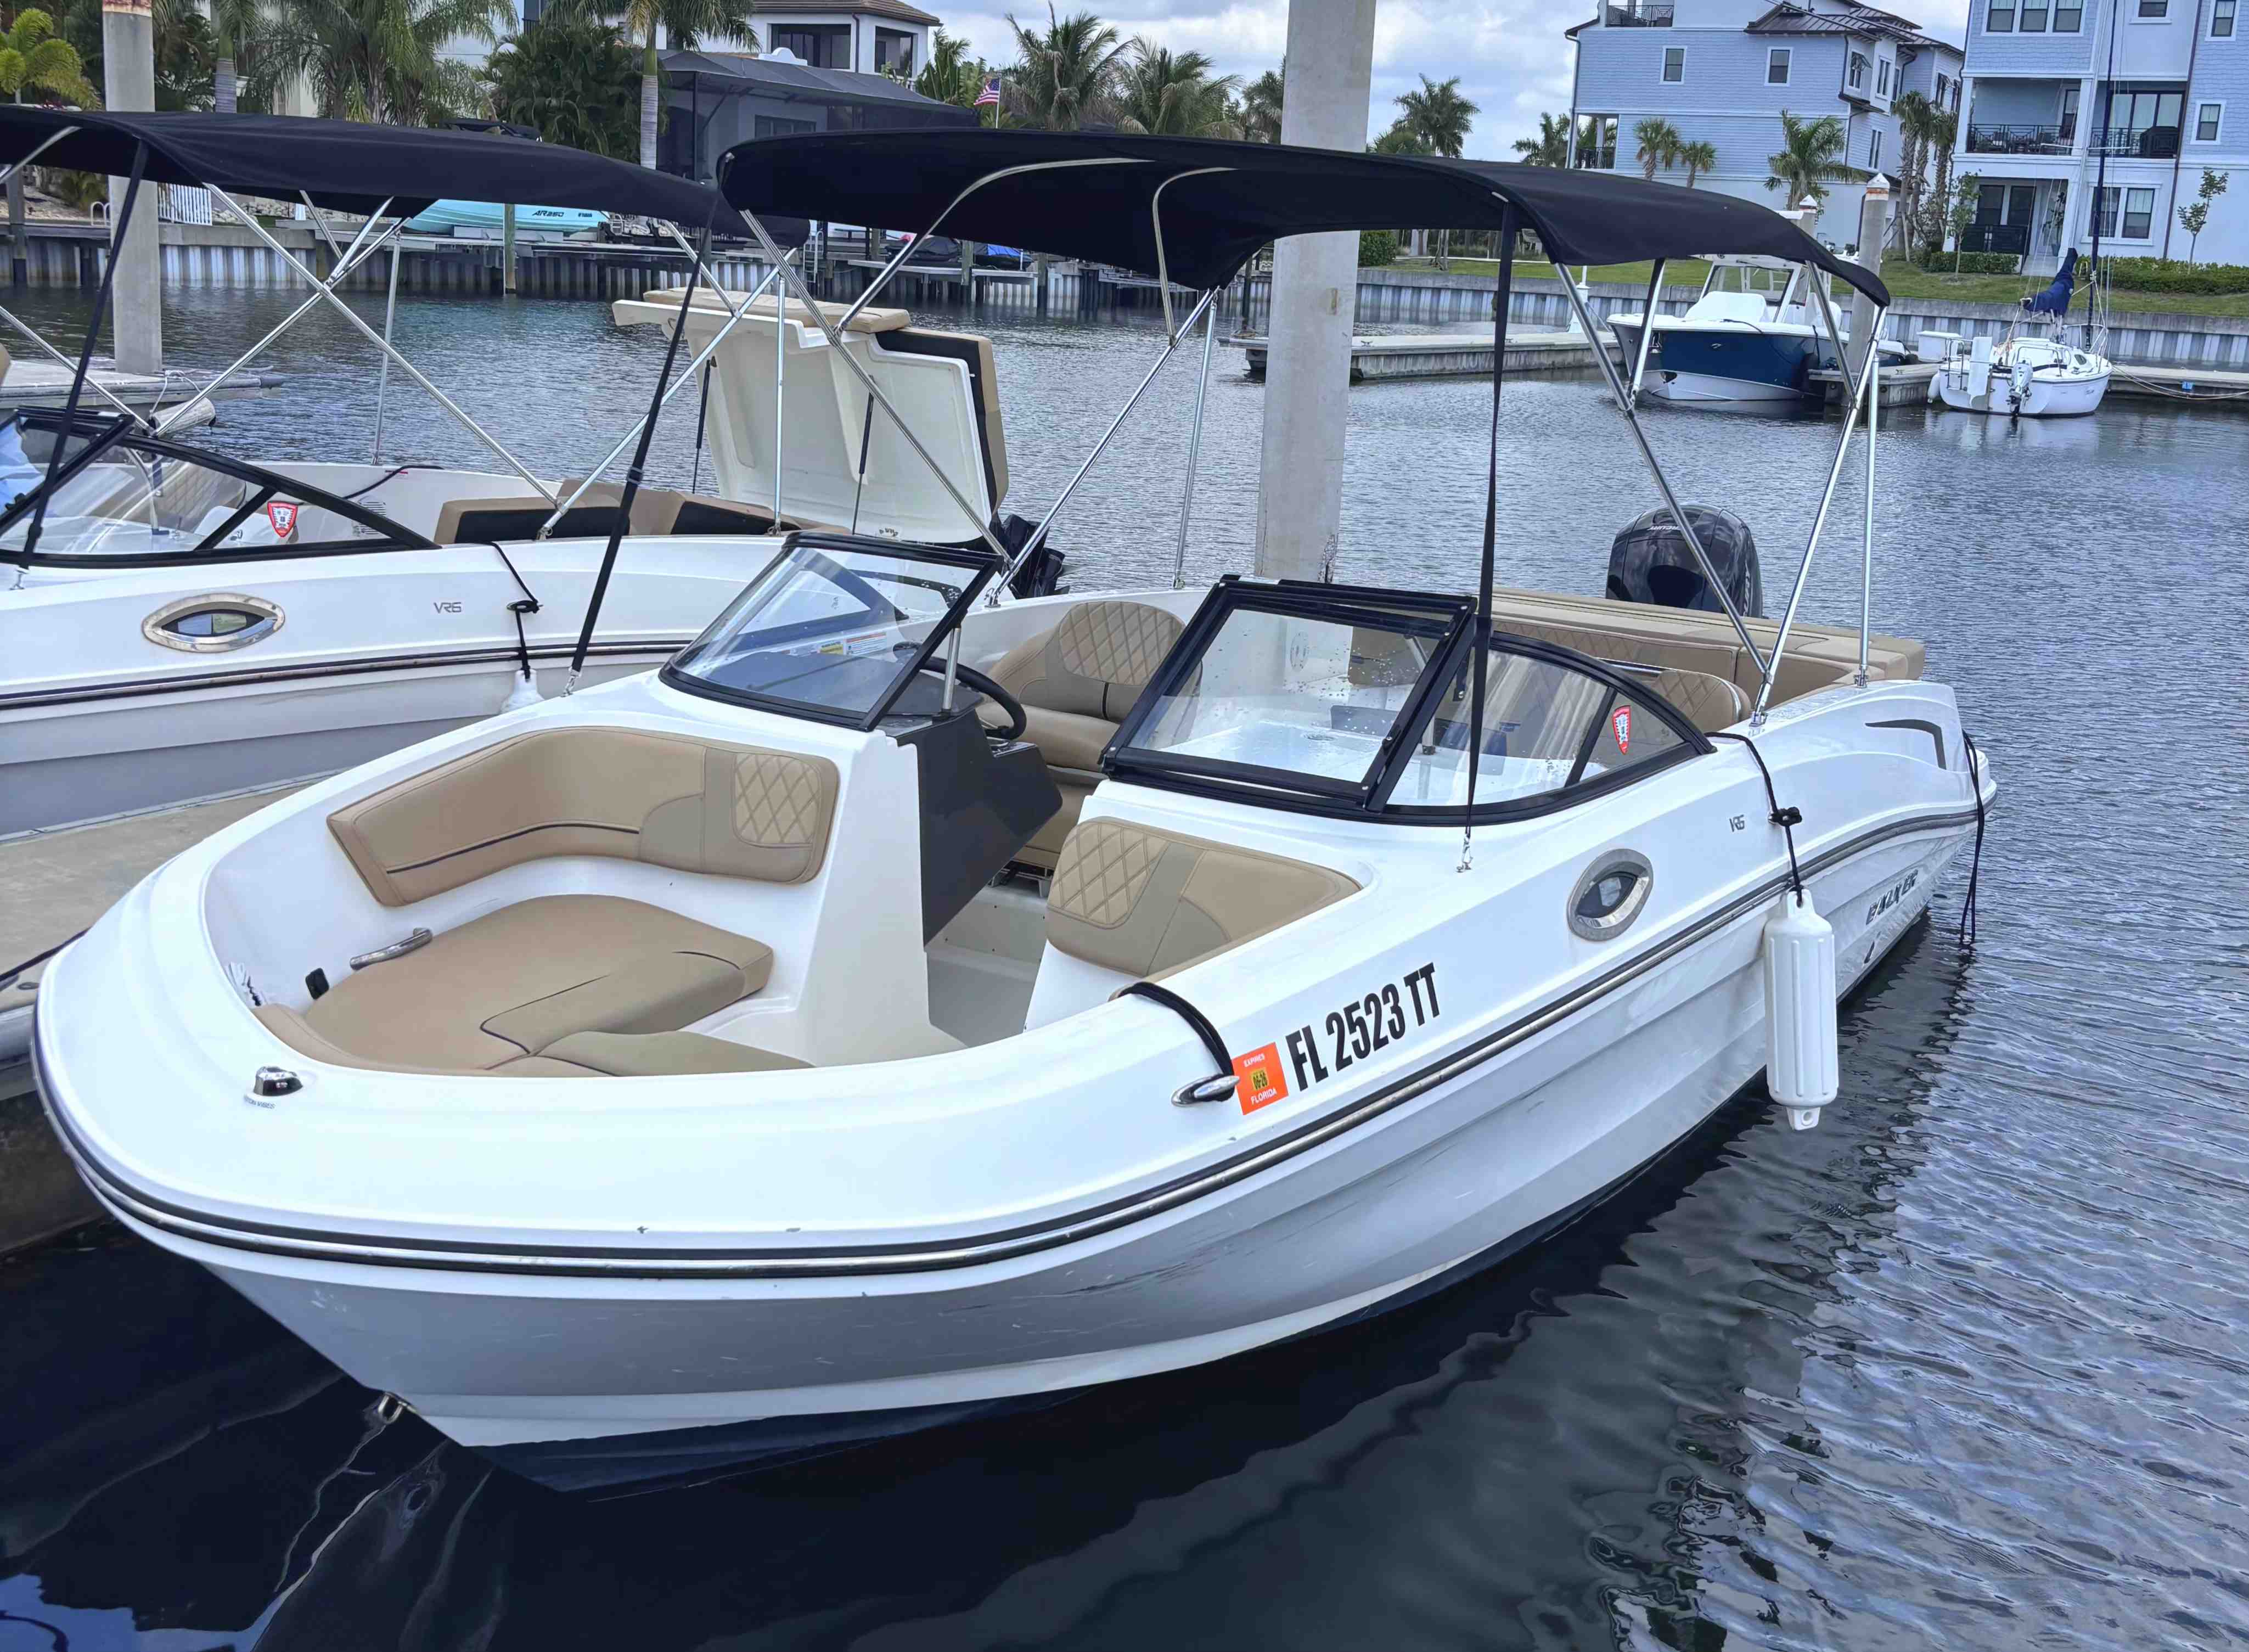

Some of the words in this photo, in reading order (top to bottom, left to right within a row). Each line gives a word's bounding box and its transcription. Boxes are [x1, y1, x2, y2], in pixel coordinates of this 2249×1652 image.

[434, 602, 462, 613] VR6
[1285, 1025, 1329, 1092] FL
[1325, 983, 1406, 1072] 2523
[1403, 962, 1440, 1027] TT
[1251, 1087, 1277, 1106] FLORIDA
